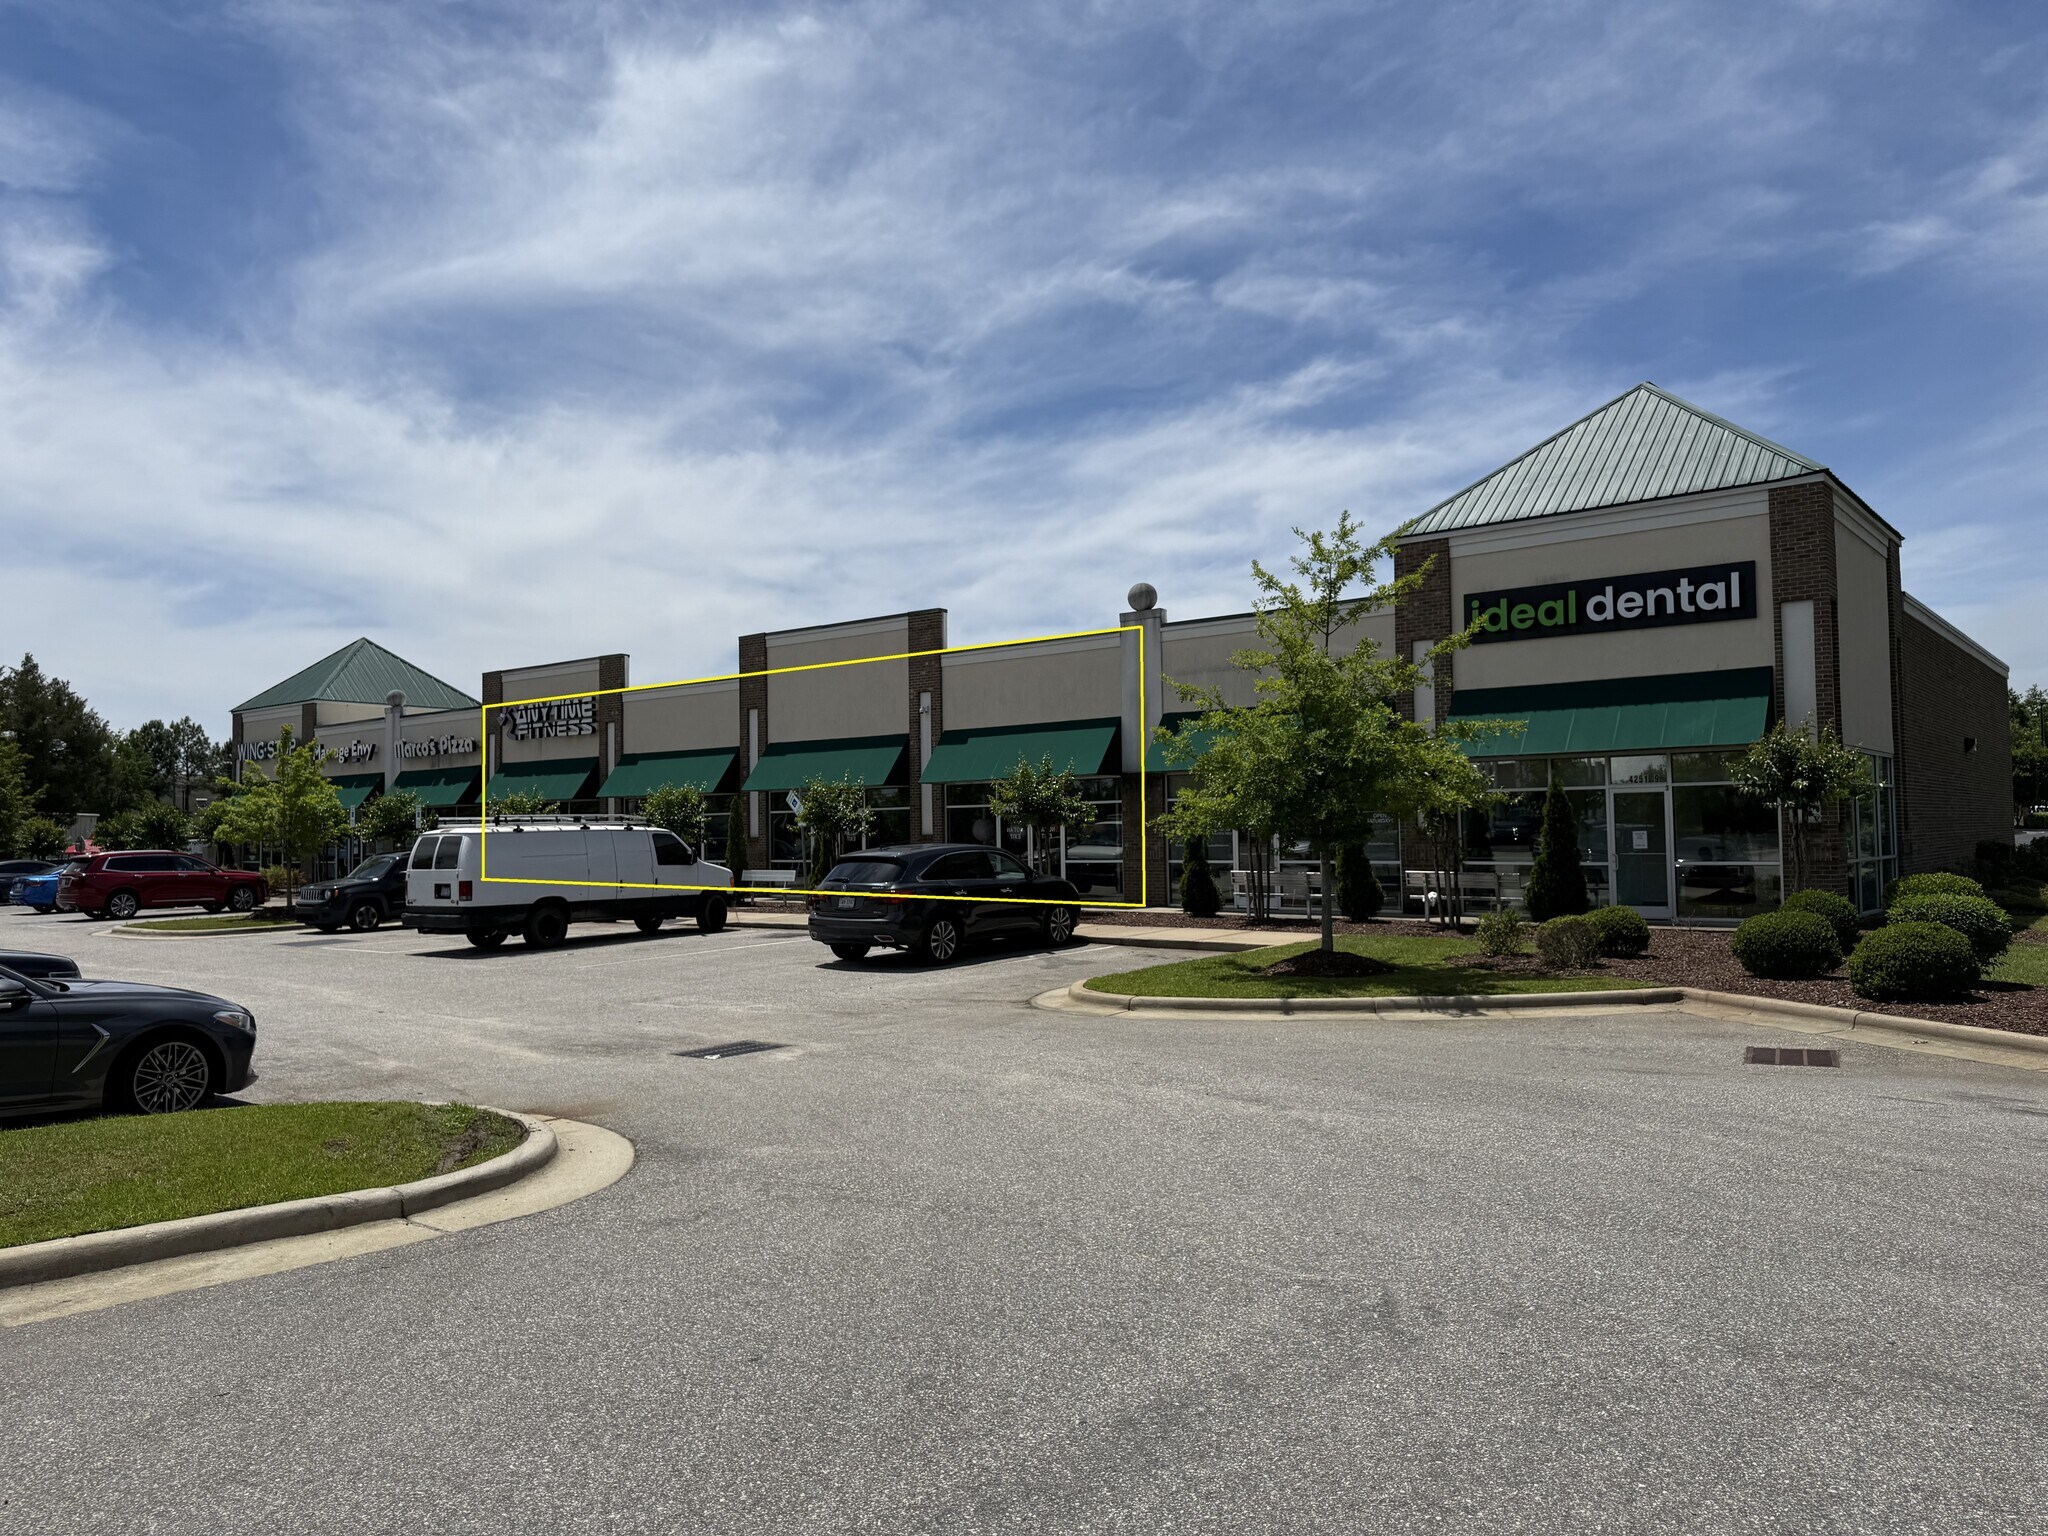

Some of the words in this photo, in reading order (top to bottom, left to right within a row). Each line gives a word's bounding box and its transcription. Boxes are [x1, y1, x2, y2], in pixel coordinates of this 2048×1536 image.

[1470, 590, 1577, 633] ideal
[1585, 571, 1741, 623] dental
[515, 696, 592, 724] ANYTIME
[516, 718, 593, 741] FITNESS
[350, 739, 374, 761] Envy
[393, 736, 436, 758] Marco's
[439, 734, 474, 755] Pizza
